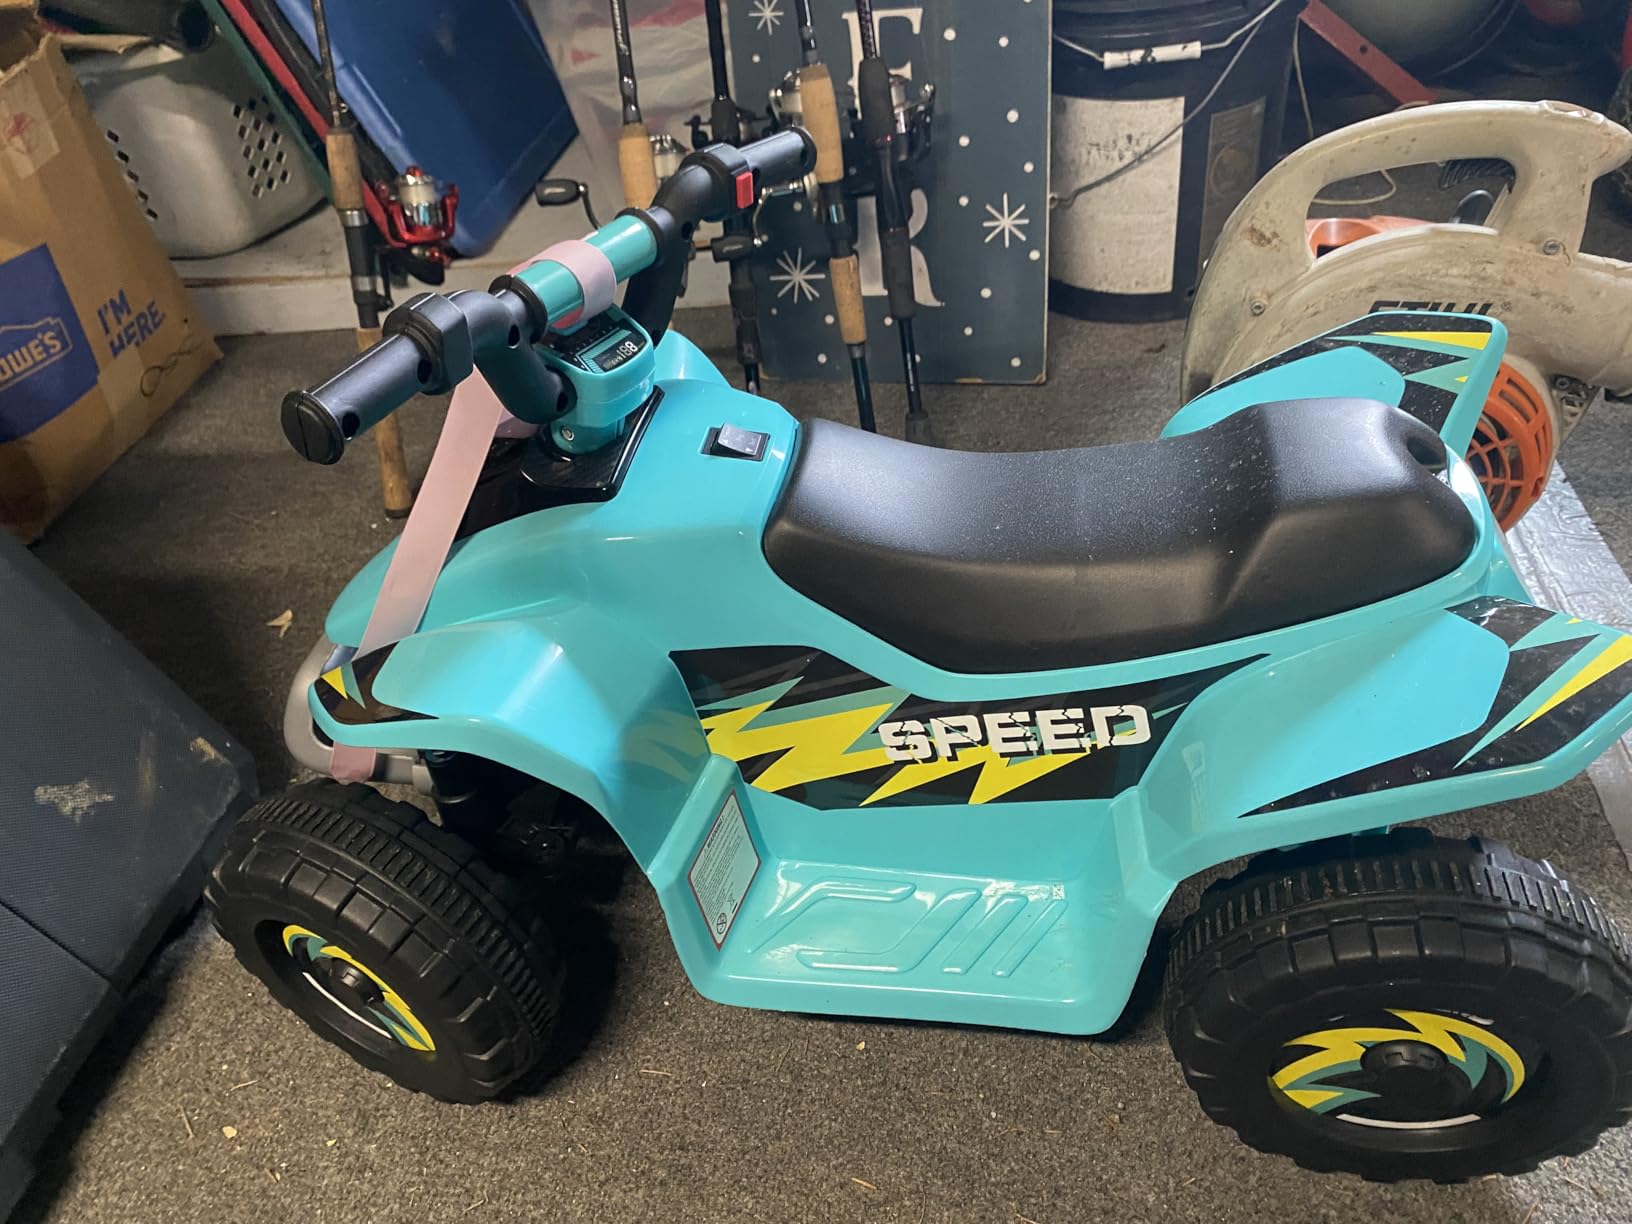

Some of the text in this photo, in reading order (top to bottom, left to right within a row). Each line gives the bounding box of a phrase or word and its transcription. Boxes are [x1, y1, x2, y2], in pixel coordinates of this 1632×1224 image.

[97, 289, 132, 335] I'M
[0, 330, 62, 381] OWE'S
[878, 704, 1151, 761] SPEED
